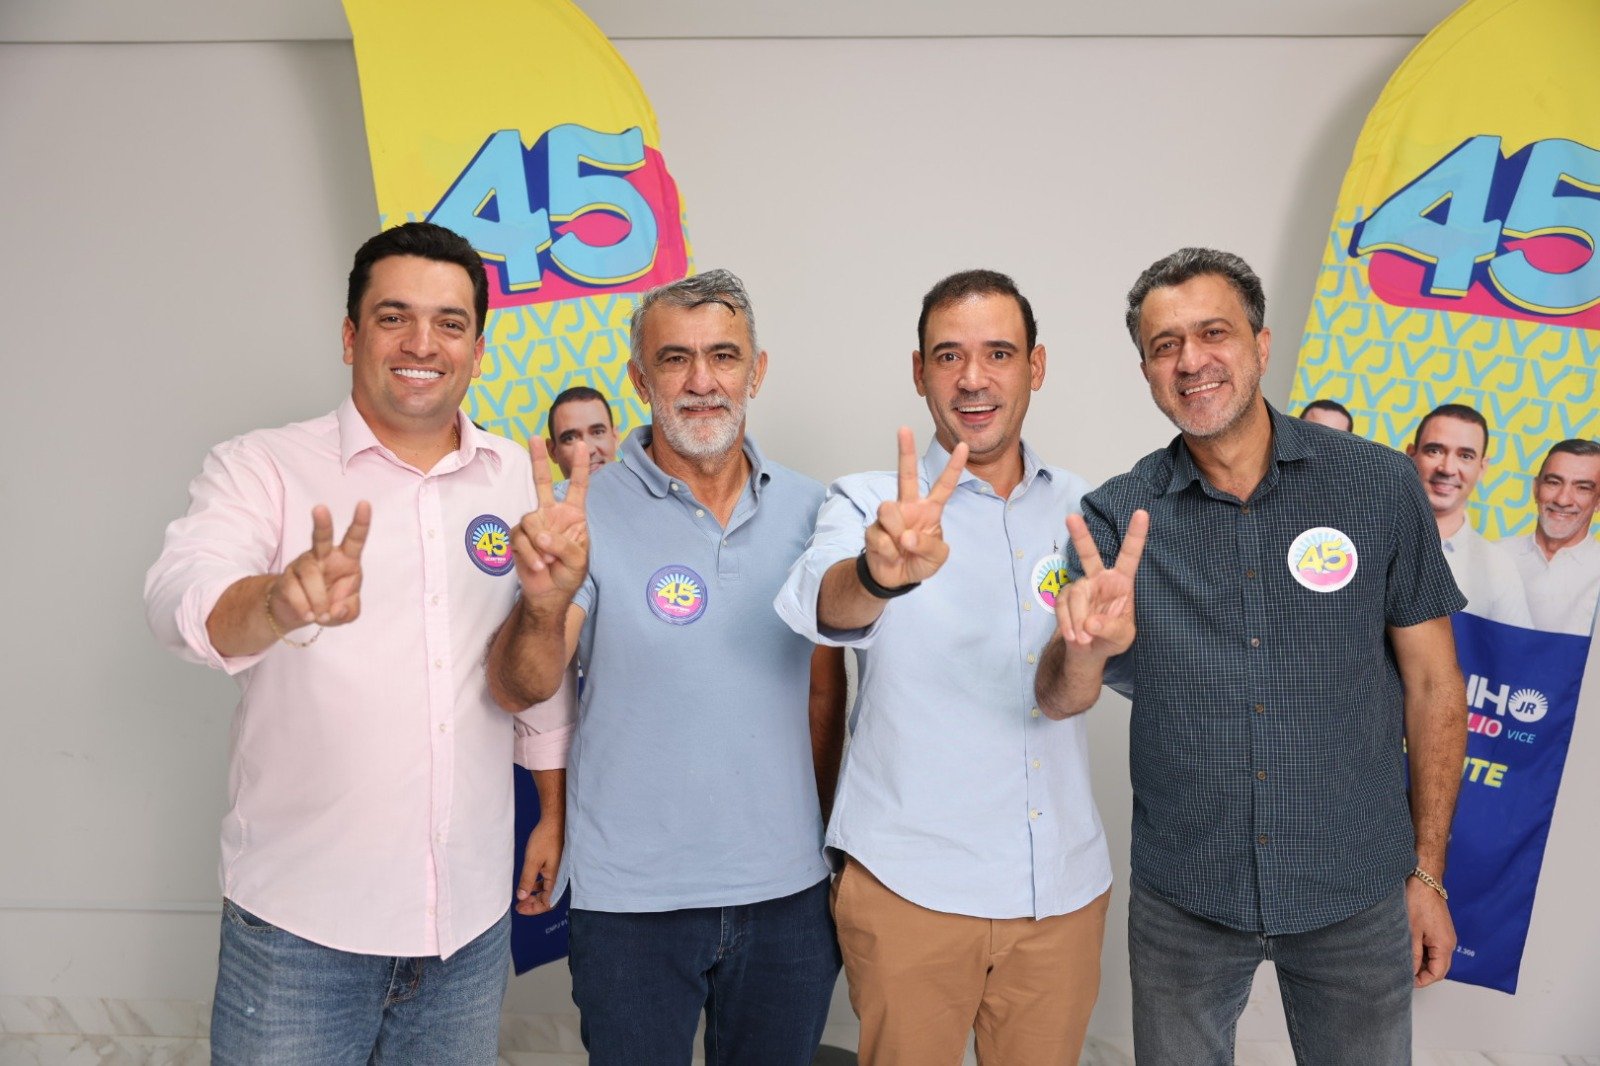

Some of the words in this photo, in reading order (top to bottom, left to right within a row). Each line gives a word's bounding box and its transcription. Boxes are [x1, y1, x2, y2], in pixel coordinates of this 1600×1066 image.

[424, 123, 659, 295] 45
[1348, 135, 1600, 317] 45
[476, 532, 507, 556] 45
[1297, 538, 1347, 574] 45
[658, 581, 695, 607] 45
[1515, 701, 1537, 715] JR
[1507, 729, 1536, 744] VICE
